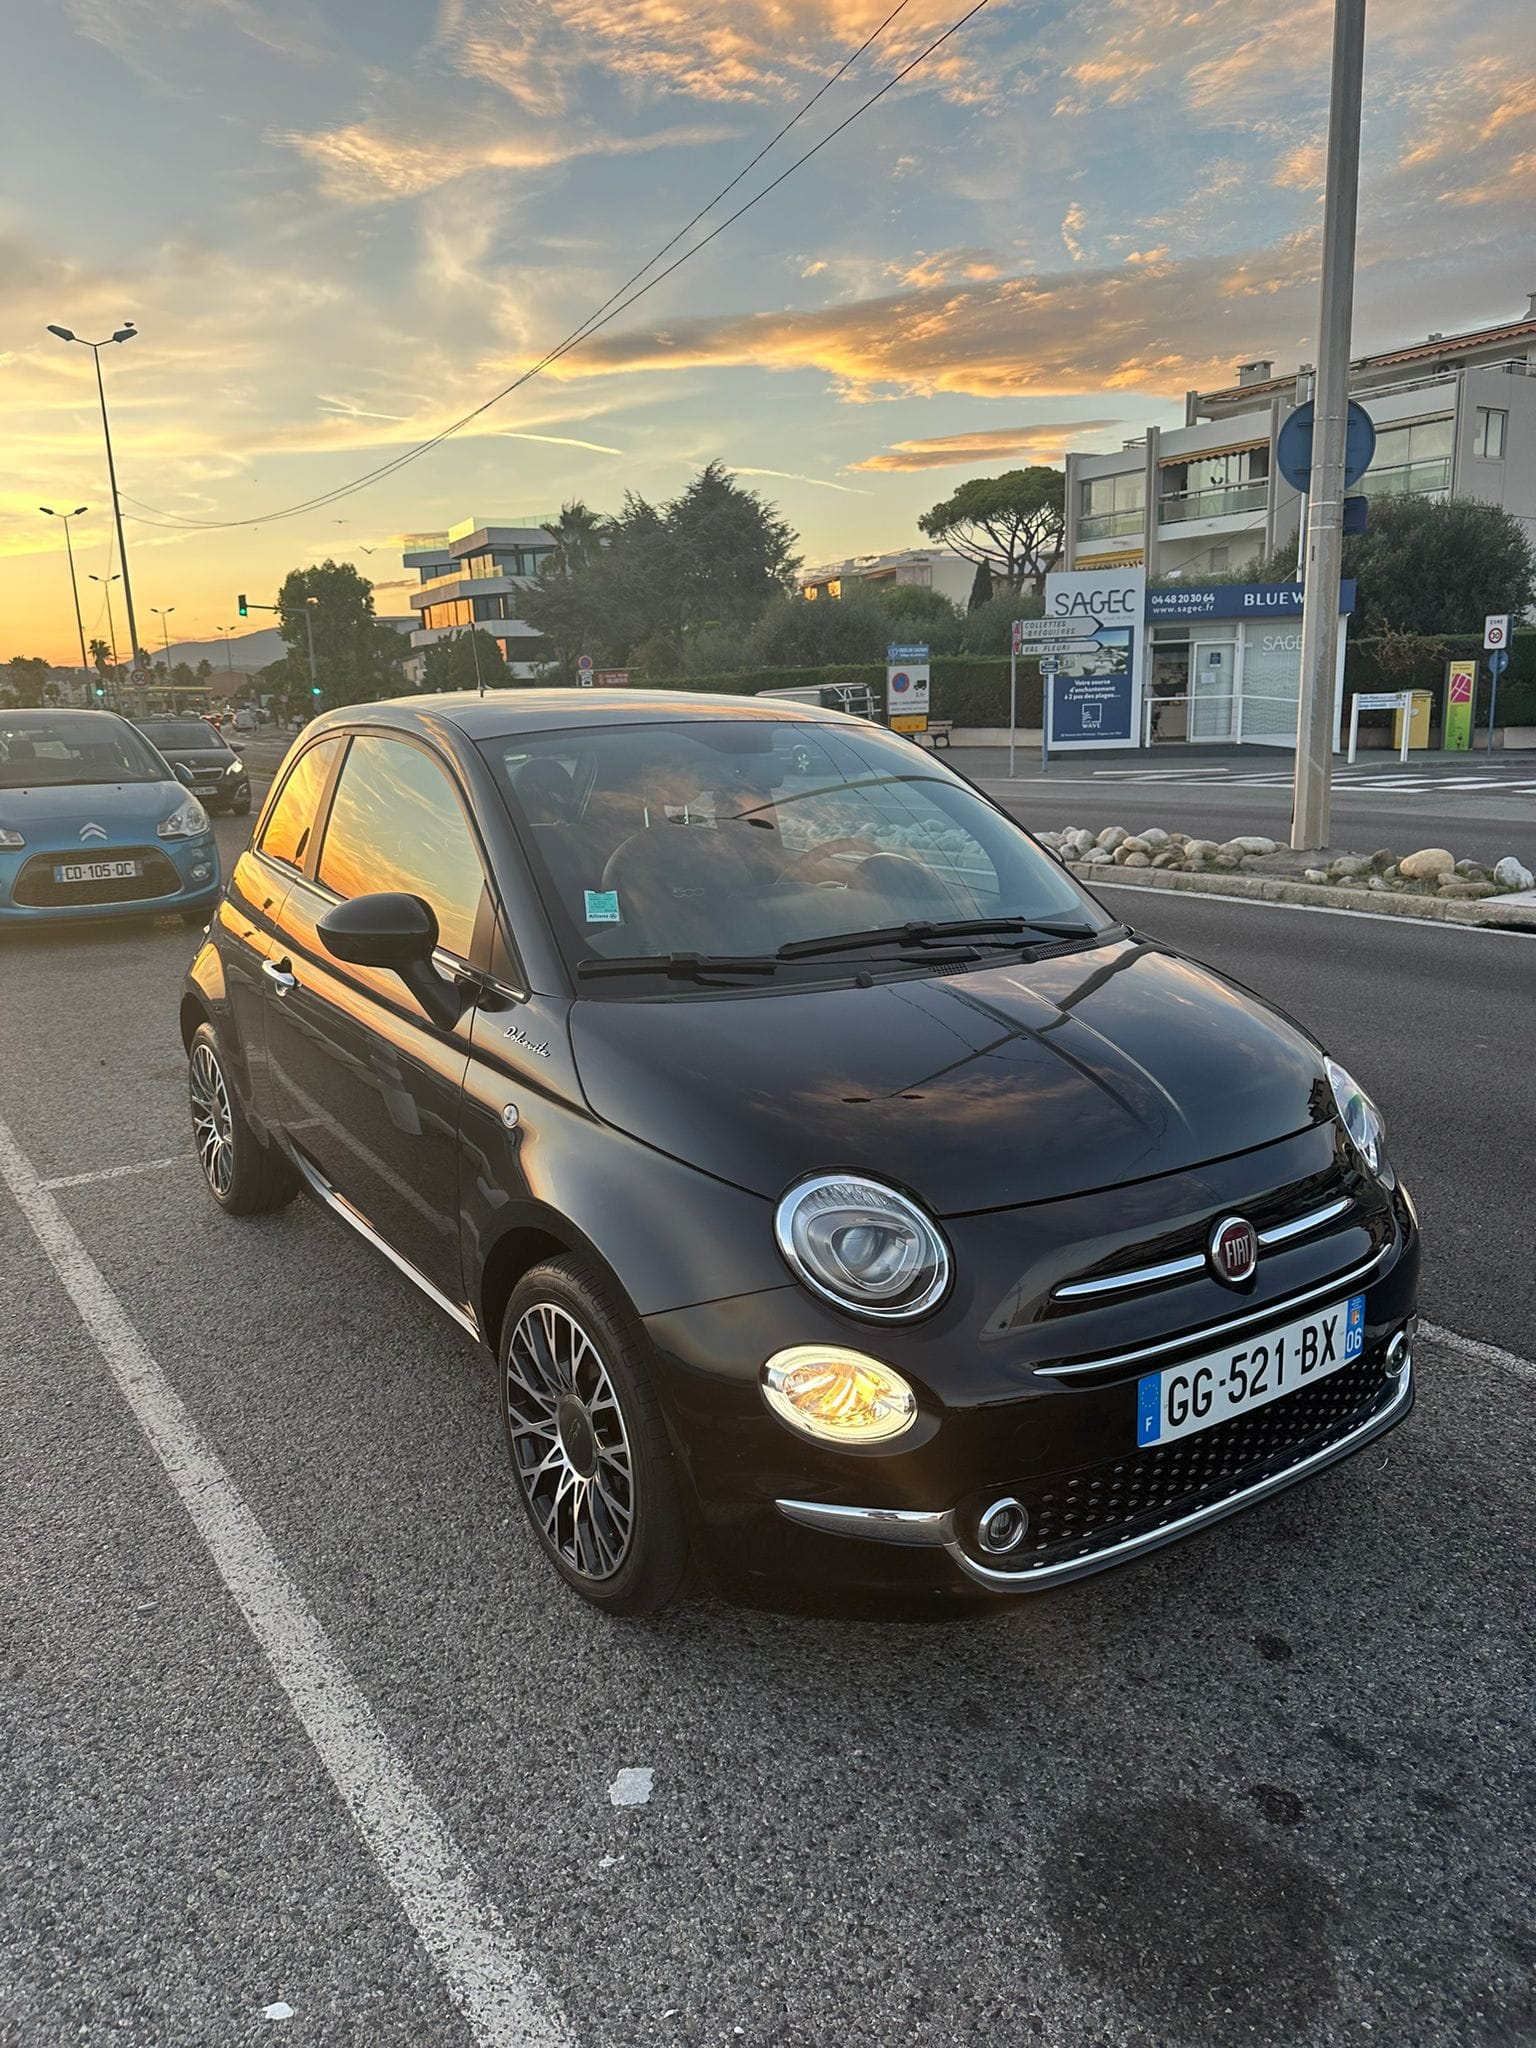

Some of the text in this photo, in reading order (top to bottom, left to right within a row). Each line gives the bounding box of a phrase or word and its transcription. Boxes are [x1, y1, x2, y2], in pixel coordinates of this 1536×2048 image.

[1055, 589, 1136, 616] SAGEC
[1151, 592, 1215, 605] 04 48 20 30 64
[1243, 591, 1305, 606] BLUE W
[1152, 603, 1214, 614] www.sagec.fr
[1024, 620, 1067, 629] COLLETTES
[1024, 645, 1038, 653] VAL
[1043, 644, 1071, 652] FLEURI
[1262, 634, 1304, 651] SAGE
[1224, 1234, 1250, 1269] FIAT
[1346, 1327, 1362, 1353] 06
[1166, 1314, 1339, 1427] GG-521-BX
[1145, 1416, 1153, 1433] F
